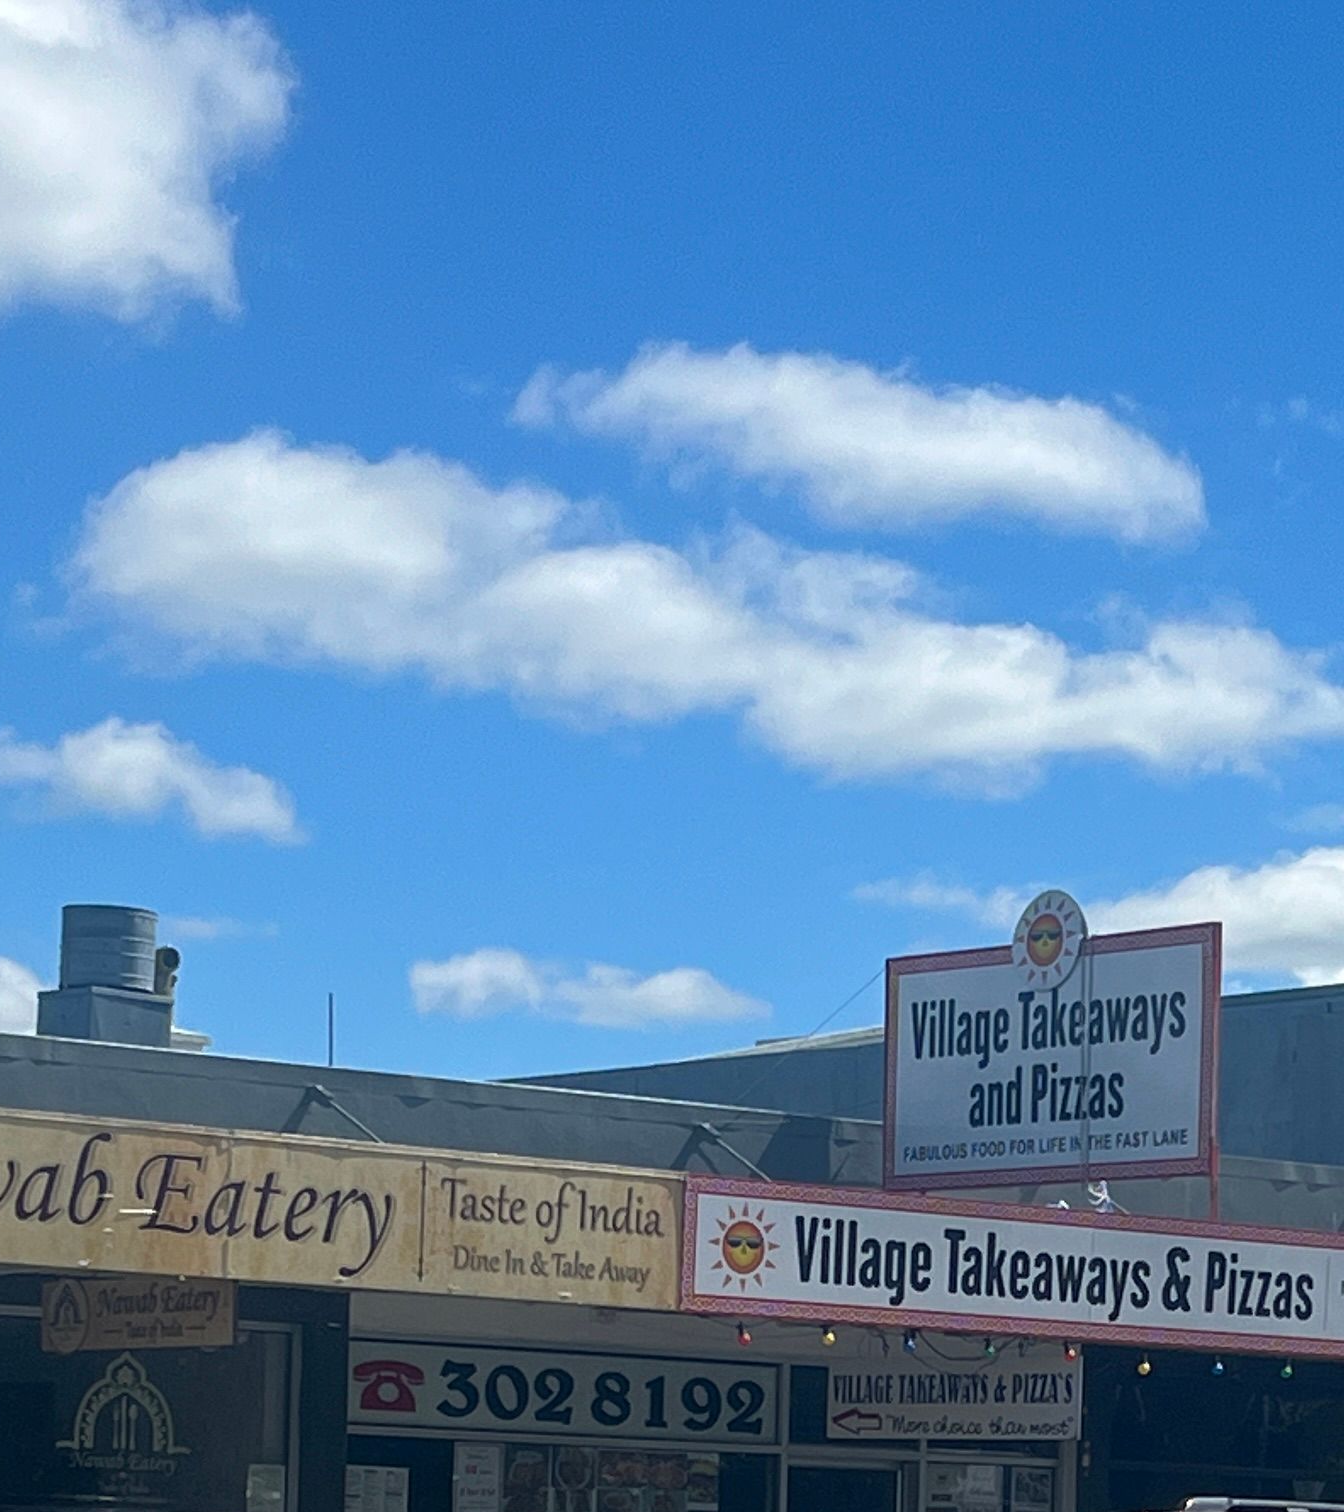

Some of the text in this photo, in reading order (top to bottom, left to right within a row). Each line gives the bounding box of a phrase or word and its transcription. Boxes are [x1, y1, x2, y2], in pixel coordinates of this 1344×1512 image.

[911, 985, 1187, 1069] Village Takeaways
[969, 1063, 1124, 1128] and Pizzas
[903, 1142, 968, 1163] FABULOUS
[971, 1140, 1006, 1157] FOOD
[1009, 1139, 1035, 1156] FOR
[1039, 1137, 1066, 1155] LIFE
[1088, 1133, 1112, 1150] THE
[1116, 1131, 1148, 1149] FAST
[1153, 1128, 1188, 1147] LANE
[137, 1154, 394, 1277] Eatery
[441, 1177, 666, 1244] Taste of India
[453, 1245, 650, 1293] Dine In & Take Away
[795, 1215, 1314, 1321] Village Takeaways & Pizzas
[96, 1281, 221, 1321] Nawab Eatery
[436, 1358, 765, 1436] 302 8192
[832, 1373, 893, 1404] VILLAGE
[899, 1373, 988, 1405] TAKEAWAYS
[994, 1375, 1007, 1404] &
[933, 1414, 983, 1436] choice
[989, 1416, 1026, 1435] than
